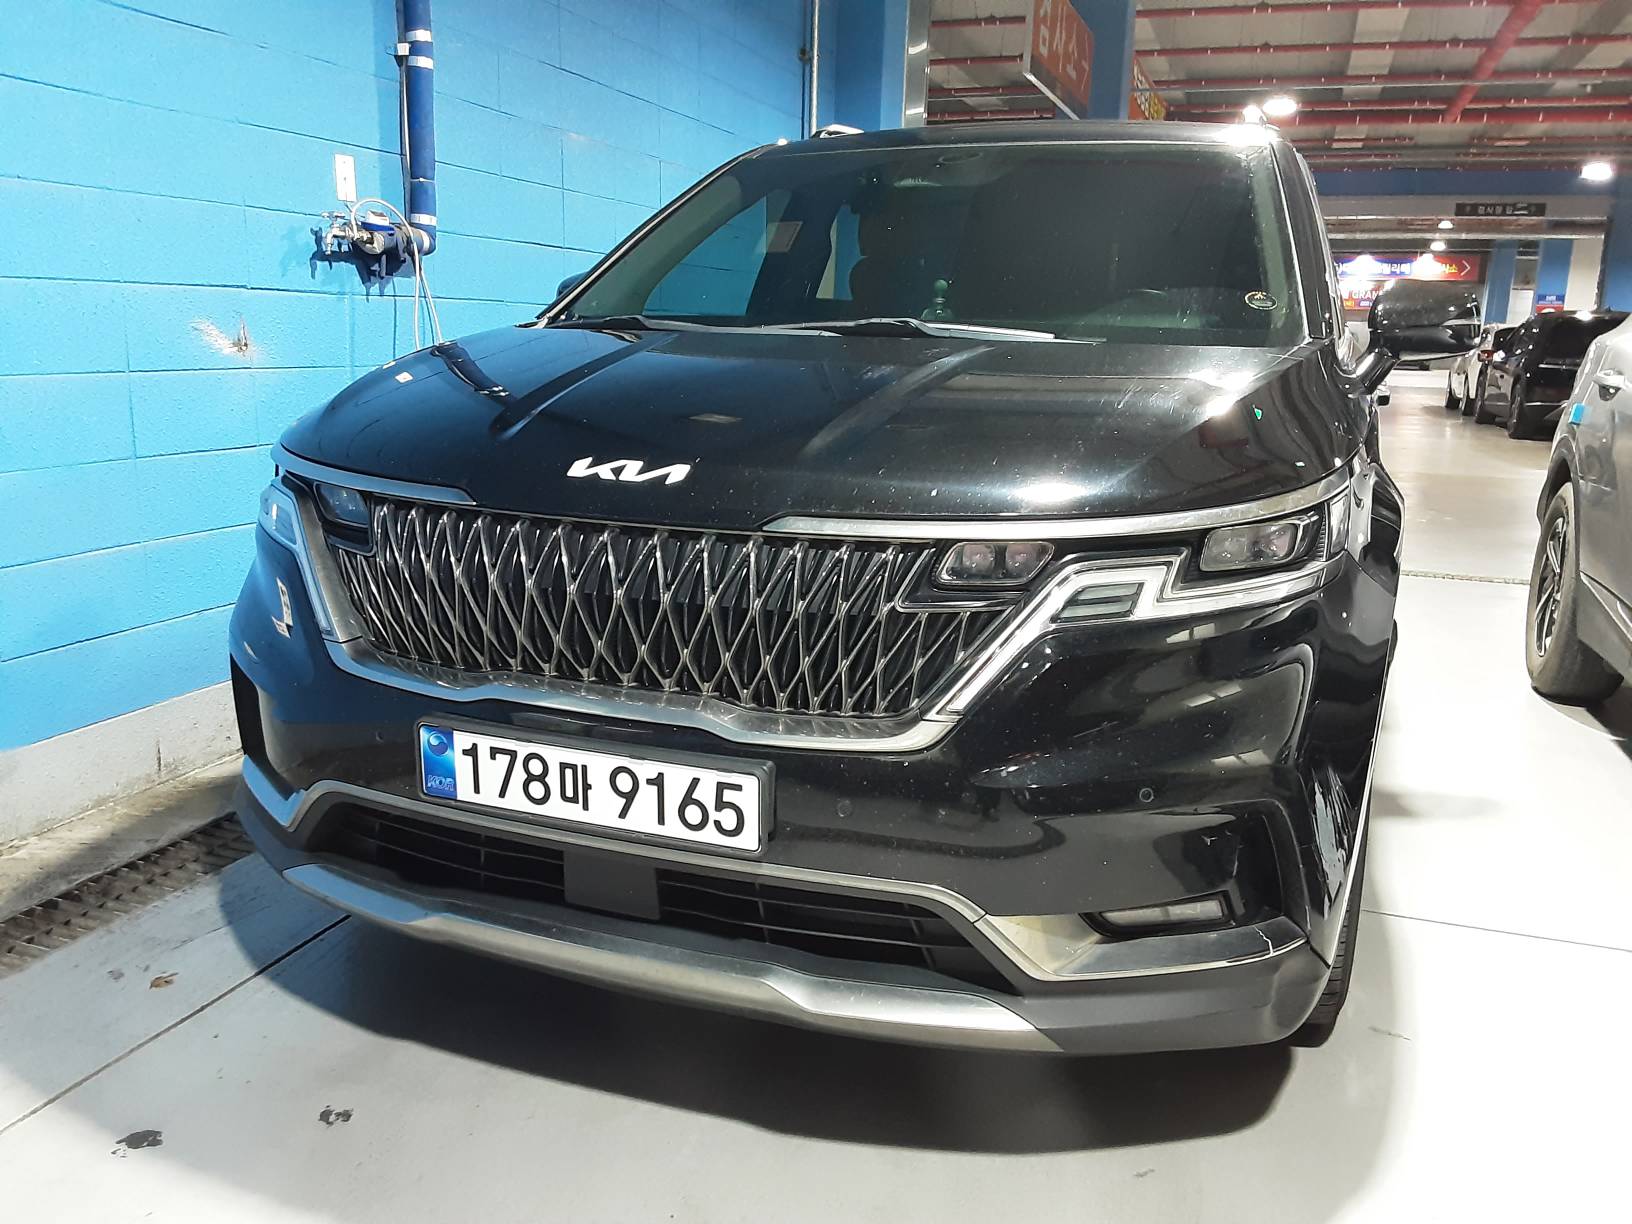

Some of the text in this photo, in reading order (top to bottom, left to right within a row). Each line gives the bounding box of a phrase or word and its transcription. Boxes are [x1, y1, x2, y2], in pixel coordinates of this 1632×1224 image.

[566, 456, 691, 485] KIA
[427, 774, 455, 792] KOR
[462, 742, 745, 838] 178마 9165
